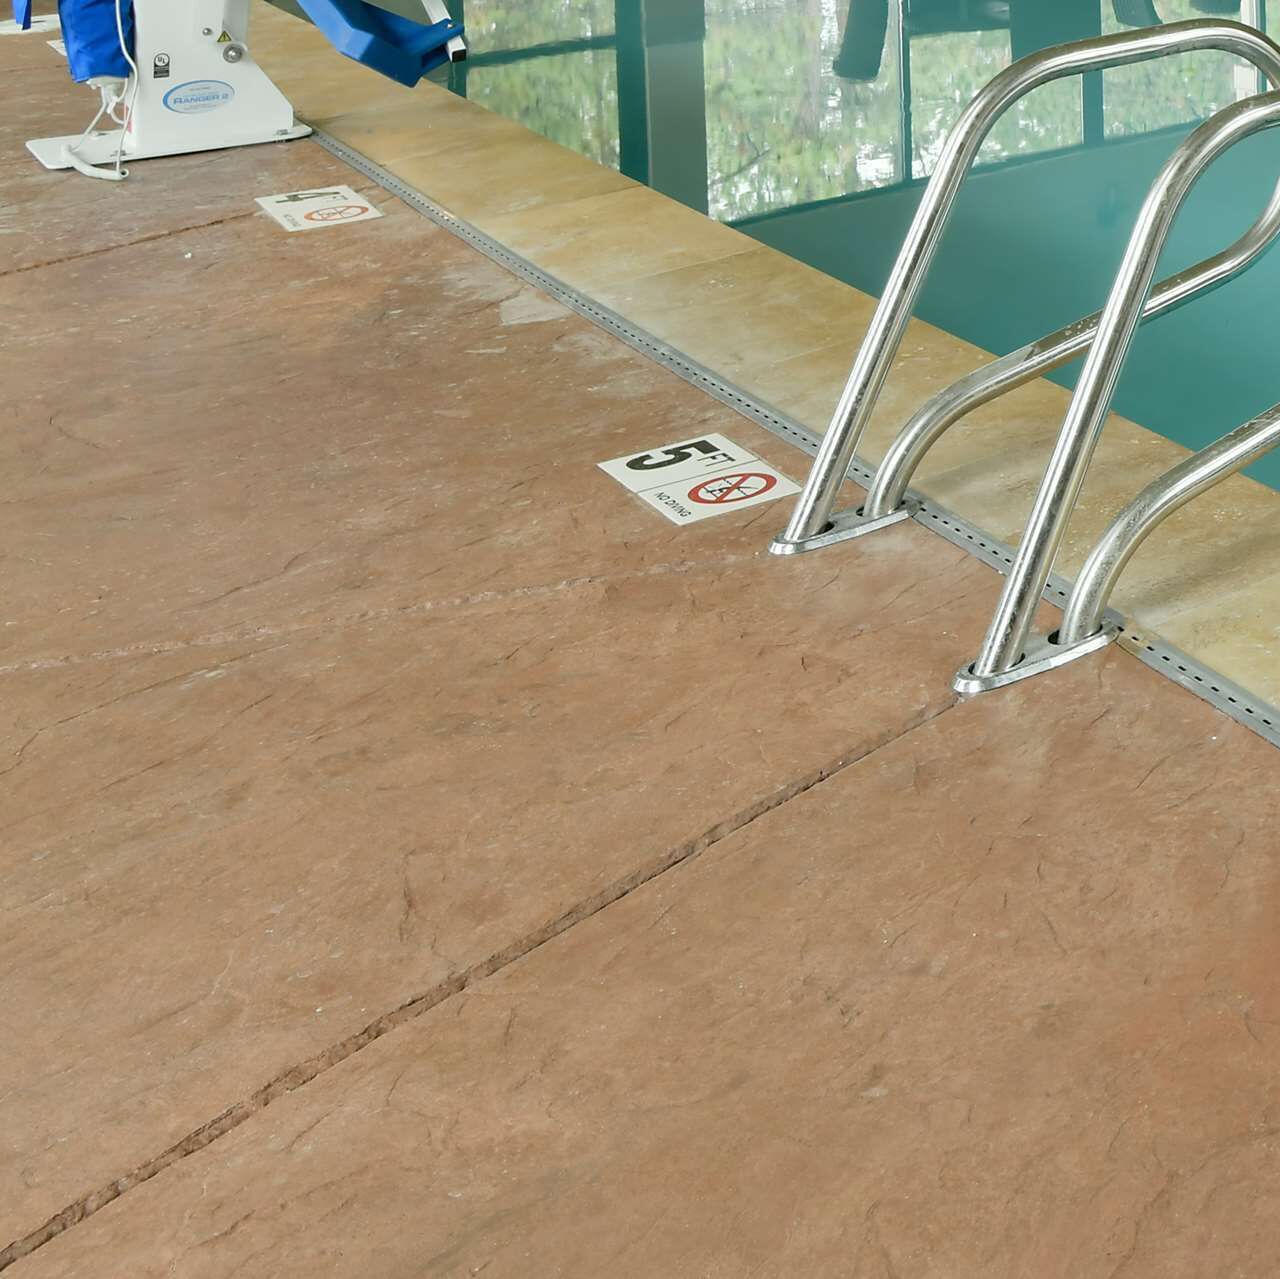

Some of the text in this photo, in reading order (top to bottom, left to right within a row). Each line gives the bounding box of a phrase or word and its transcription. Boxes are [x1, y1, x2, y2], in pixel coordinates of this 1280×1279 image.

[174, 92, 229, 105] RANGER 2
[625, 439, 736, 471] 5 FT
[664, 499, 692, 518] DIVING
